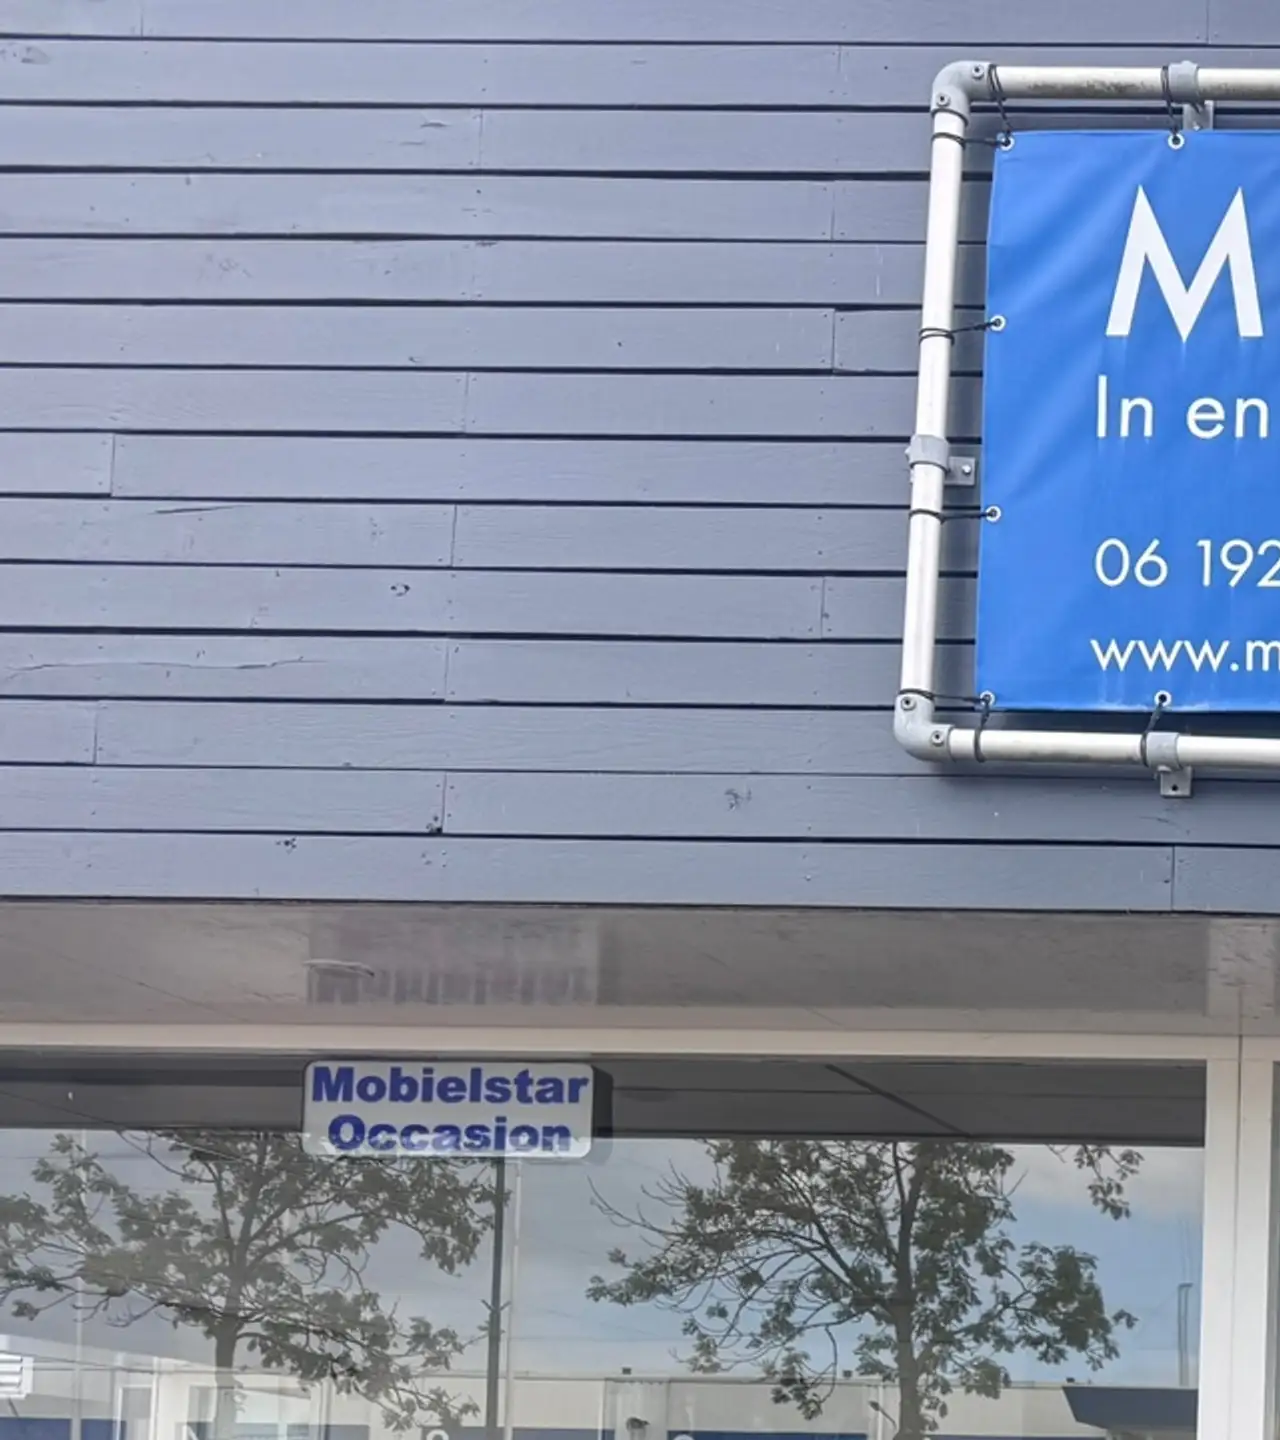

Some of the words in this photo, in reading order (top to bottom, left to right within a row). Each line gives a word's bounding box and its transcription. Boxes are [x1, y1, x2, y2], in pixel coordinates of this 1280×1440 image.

[1097, 375, 1153, 438] In
[1186, 397, 1269, 439] en
[1095, 538, 1168, 587] 06
[312, 1066, 589, 1104] Mobielstar
[328, 1114, 571, 1151] Occasion
